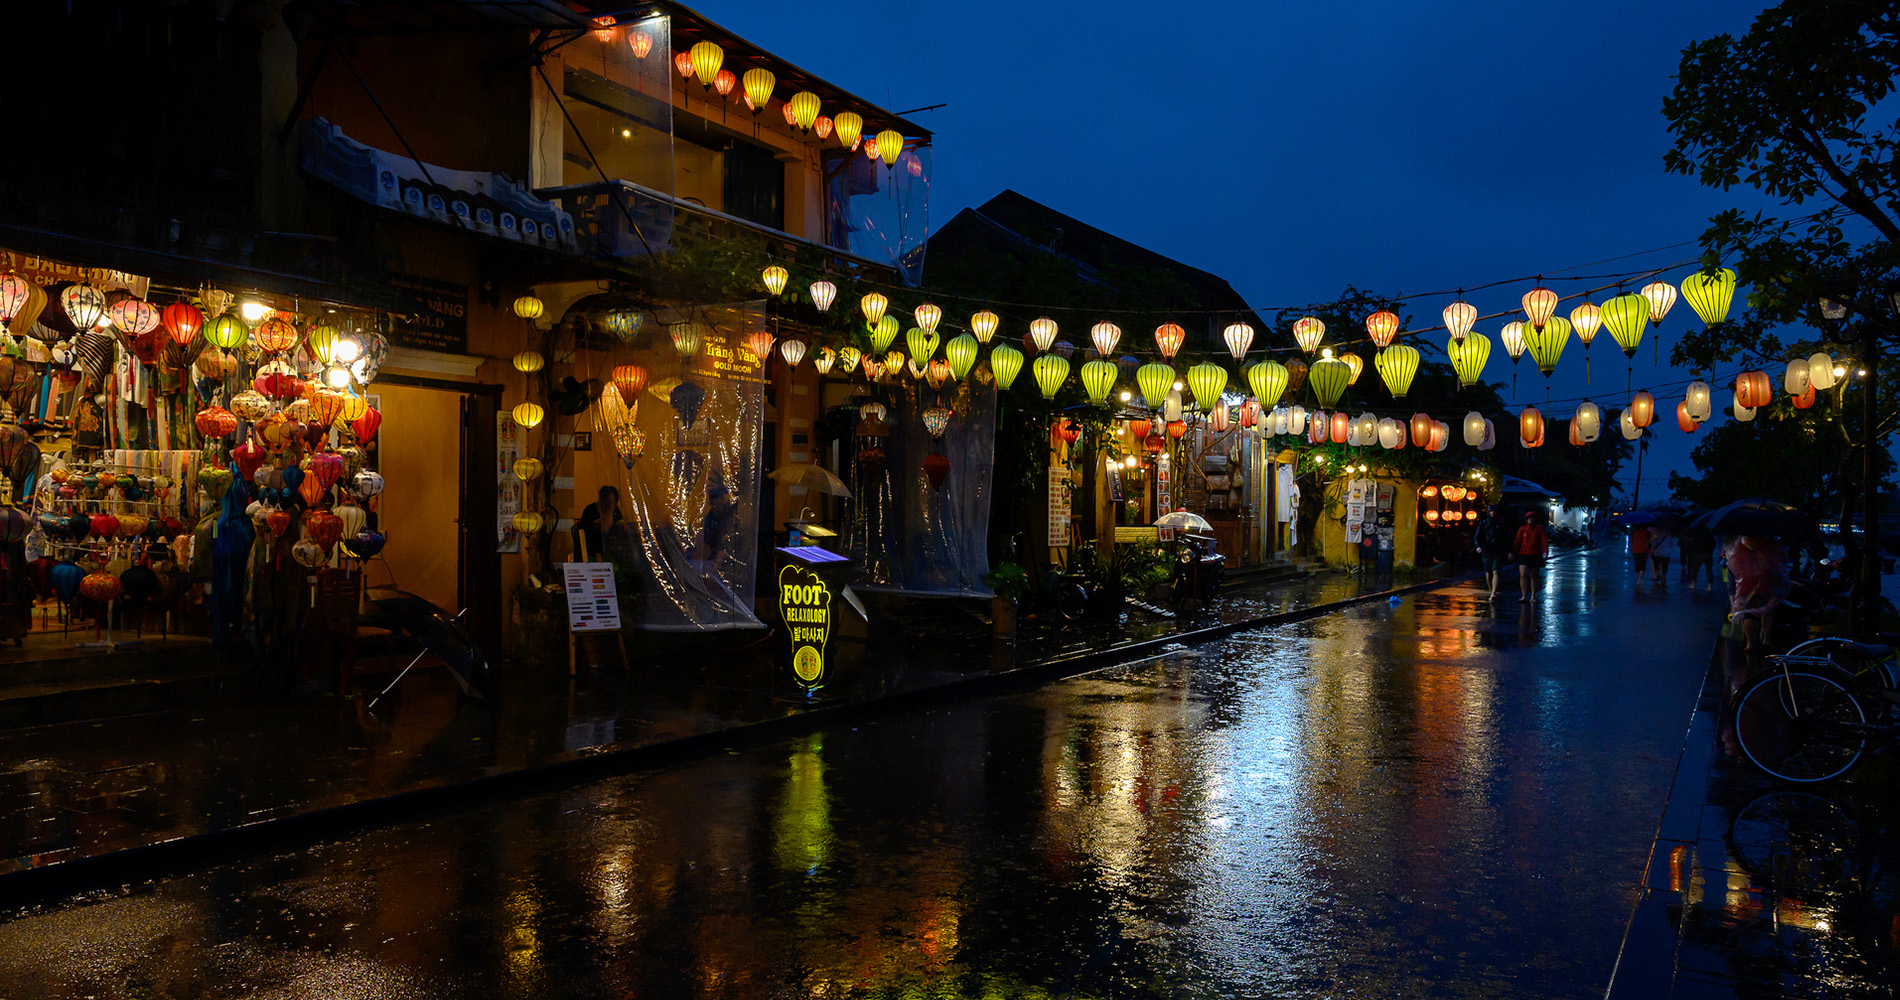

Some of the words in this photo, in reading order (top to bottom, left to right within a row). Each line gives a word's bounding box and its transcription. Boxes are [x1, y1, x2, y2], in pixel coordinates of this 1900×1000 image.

[705, 342, 734, 363] Trăng
[736, 347, 762, 368] Vàng
[714, 360, 732, 371] GOLD
[733, 364, 752, 374] MOON
[783, 584, 822, 606] FOOT
[786, 607, 826, 624] RELAXOLOGY
